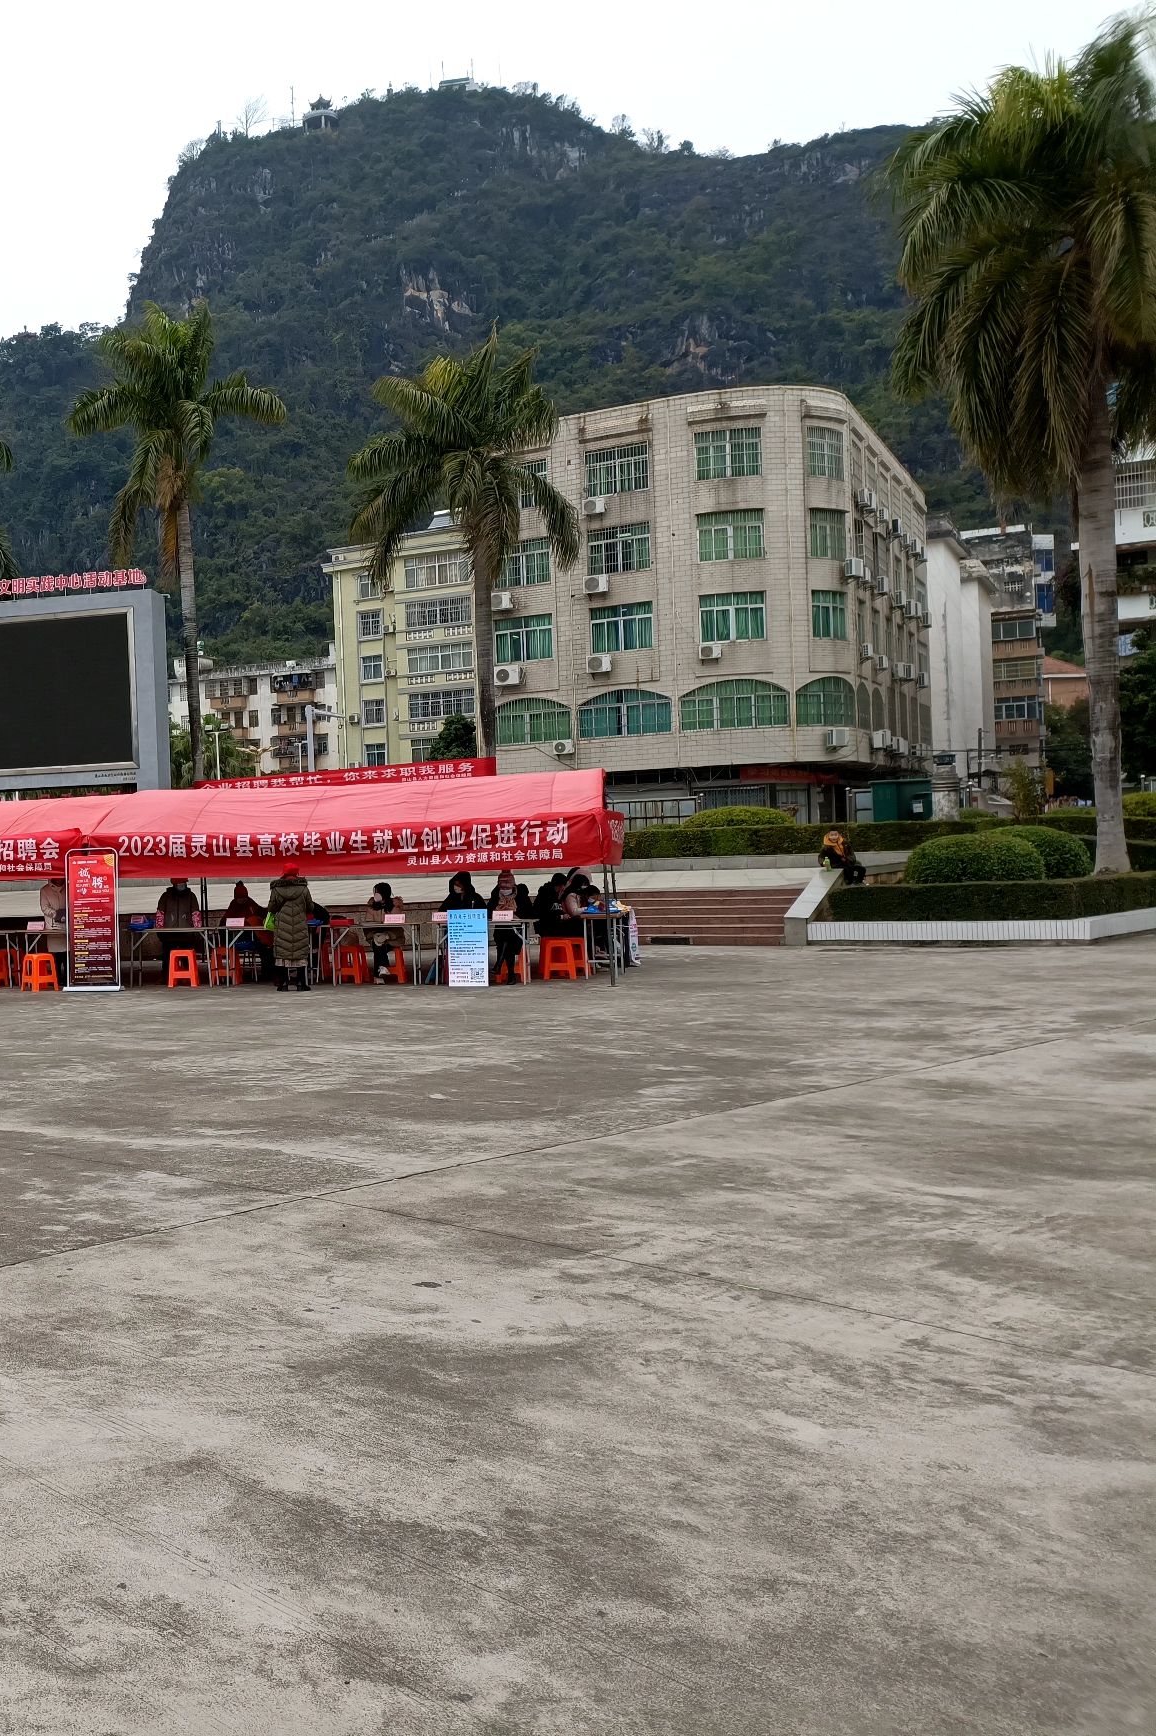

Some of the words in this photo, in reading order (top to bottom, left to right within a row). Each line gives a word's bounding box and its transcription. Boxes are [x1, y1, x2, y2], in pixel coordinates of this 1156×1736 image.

[118, 817, 569, 858] 2023届灵山县高校毕业生就业创业促进行动
[407, 848, 563, 867] 灵山县人力资源和社会保障局
